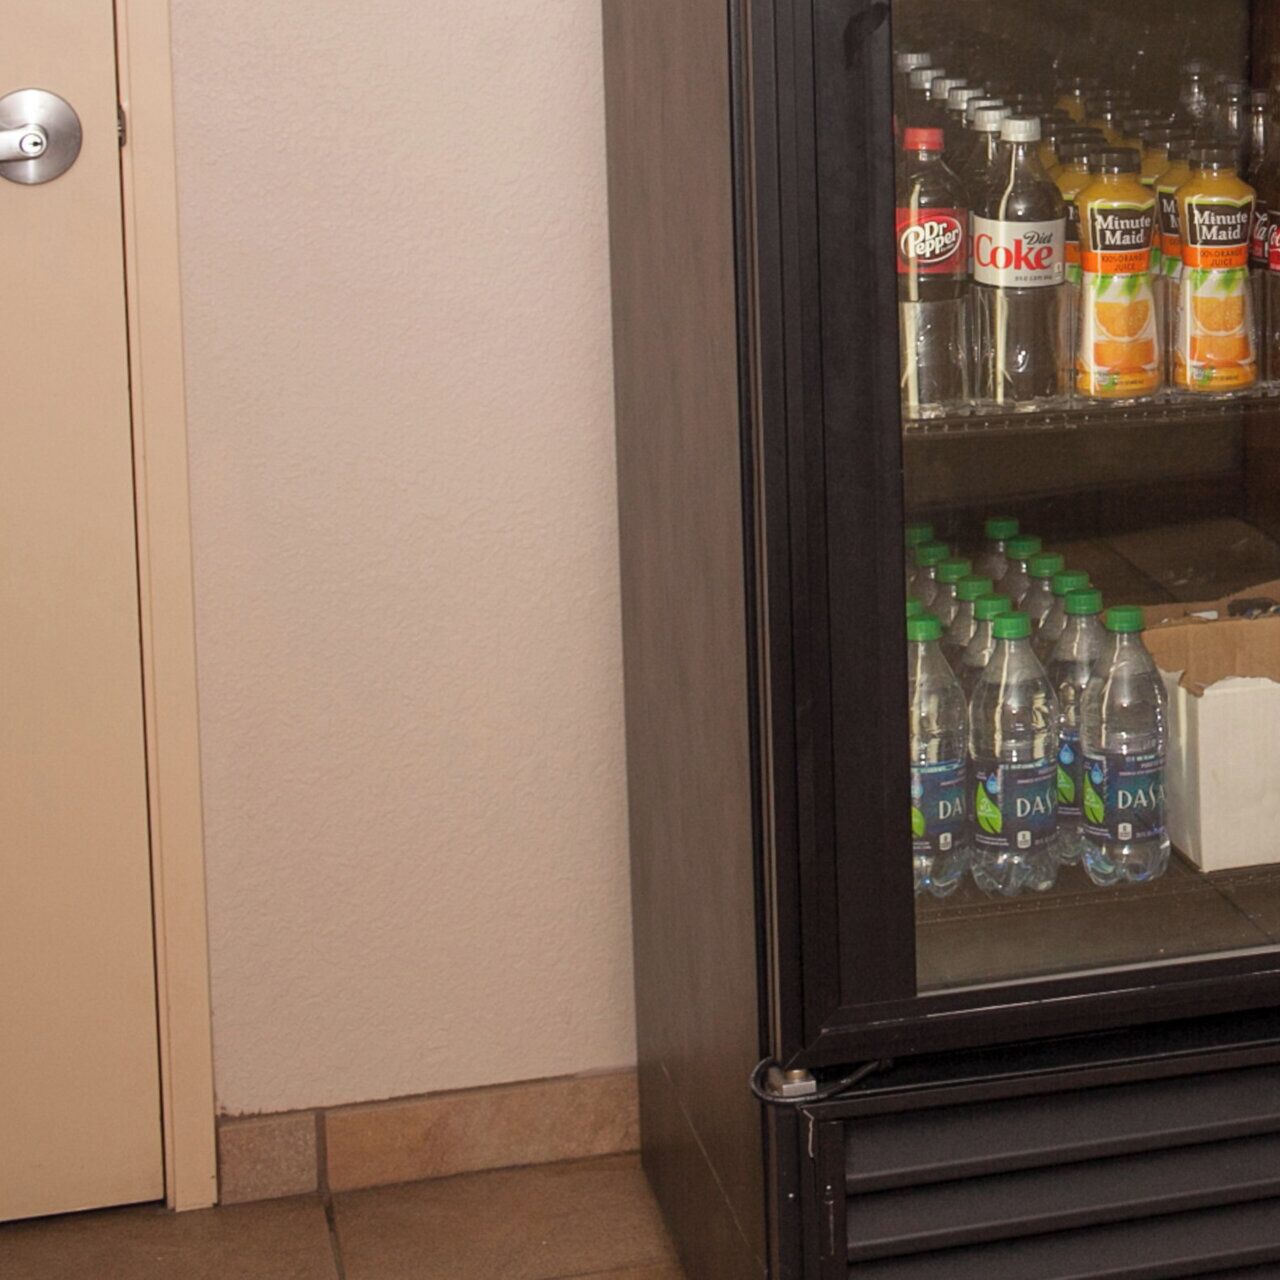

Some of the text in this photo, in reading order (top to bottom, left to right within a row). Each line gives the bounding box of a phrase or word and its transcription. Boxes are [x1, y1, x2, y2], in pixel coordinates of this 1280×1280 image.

[1097, 215, 1150, 229] Minute
[1194, 211, 1247, 225] Minute
[925, 222, 947, 240] Dr
[1024, 230, 1053, 245] Diet
[1104, 230, 1144, 245] Maid
[1200, 225, 1241, 240] Maid
[908, 226, 959, 257] Pepper
[975, 234, 1053, 270] Coke
